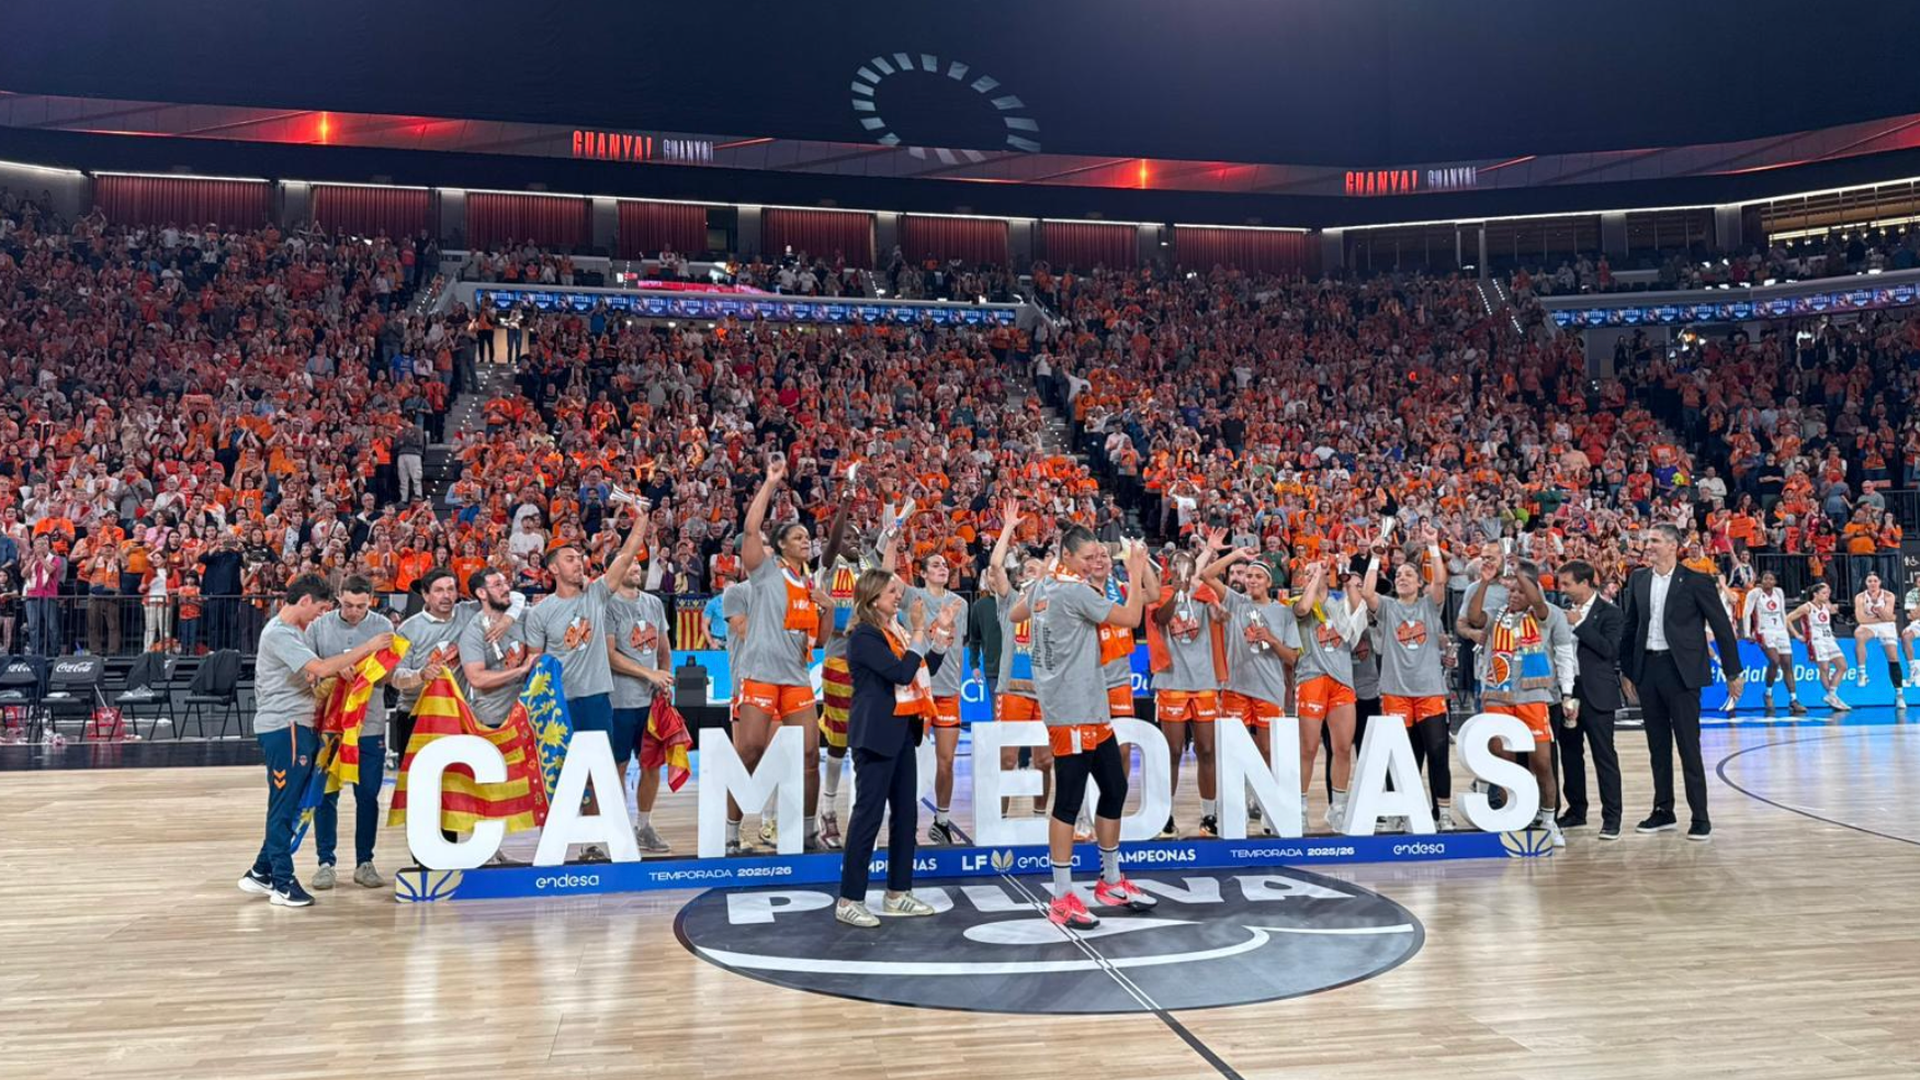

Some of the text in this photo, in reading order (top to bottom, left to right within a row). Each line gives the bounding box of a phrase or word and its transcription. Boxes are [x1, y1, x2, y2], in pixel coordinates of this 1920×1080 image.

[1116, 849, 1197, 864] AMPEONAS
[1230, 846, 1355, 859] TEMPORADA 2025/26
[1393, 842, 1445, 856] endesa
[962, 852, 1081, 871] LF enda
[535, 873, 600, 889] endesa
[649, 866, 792, 882] TEMPORADA 2025/26
